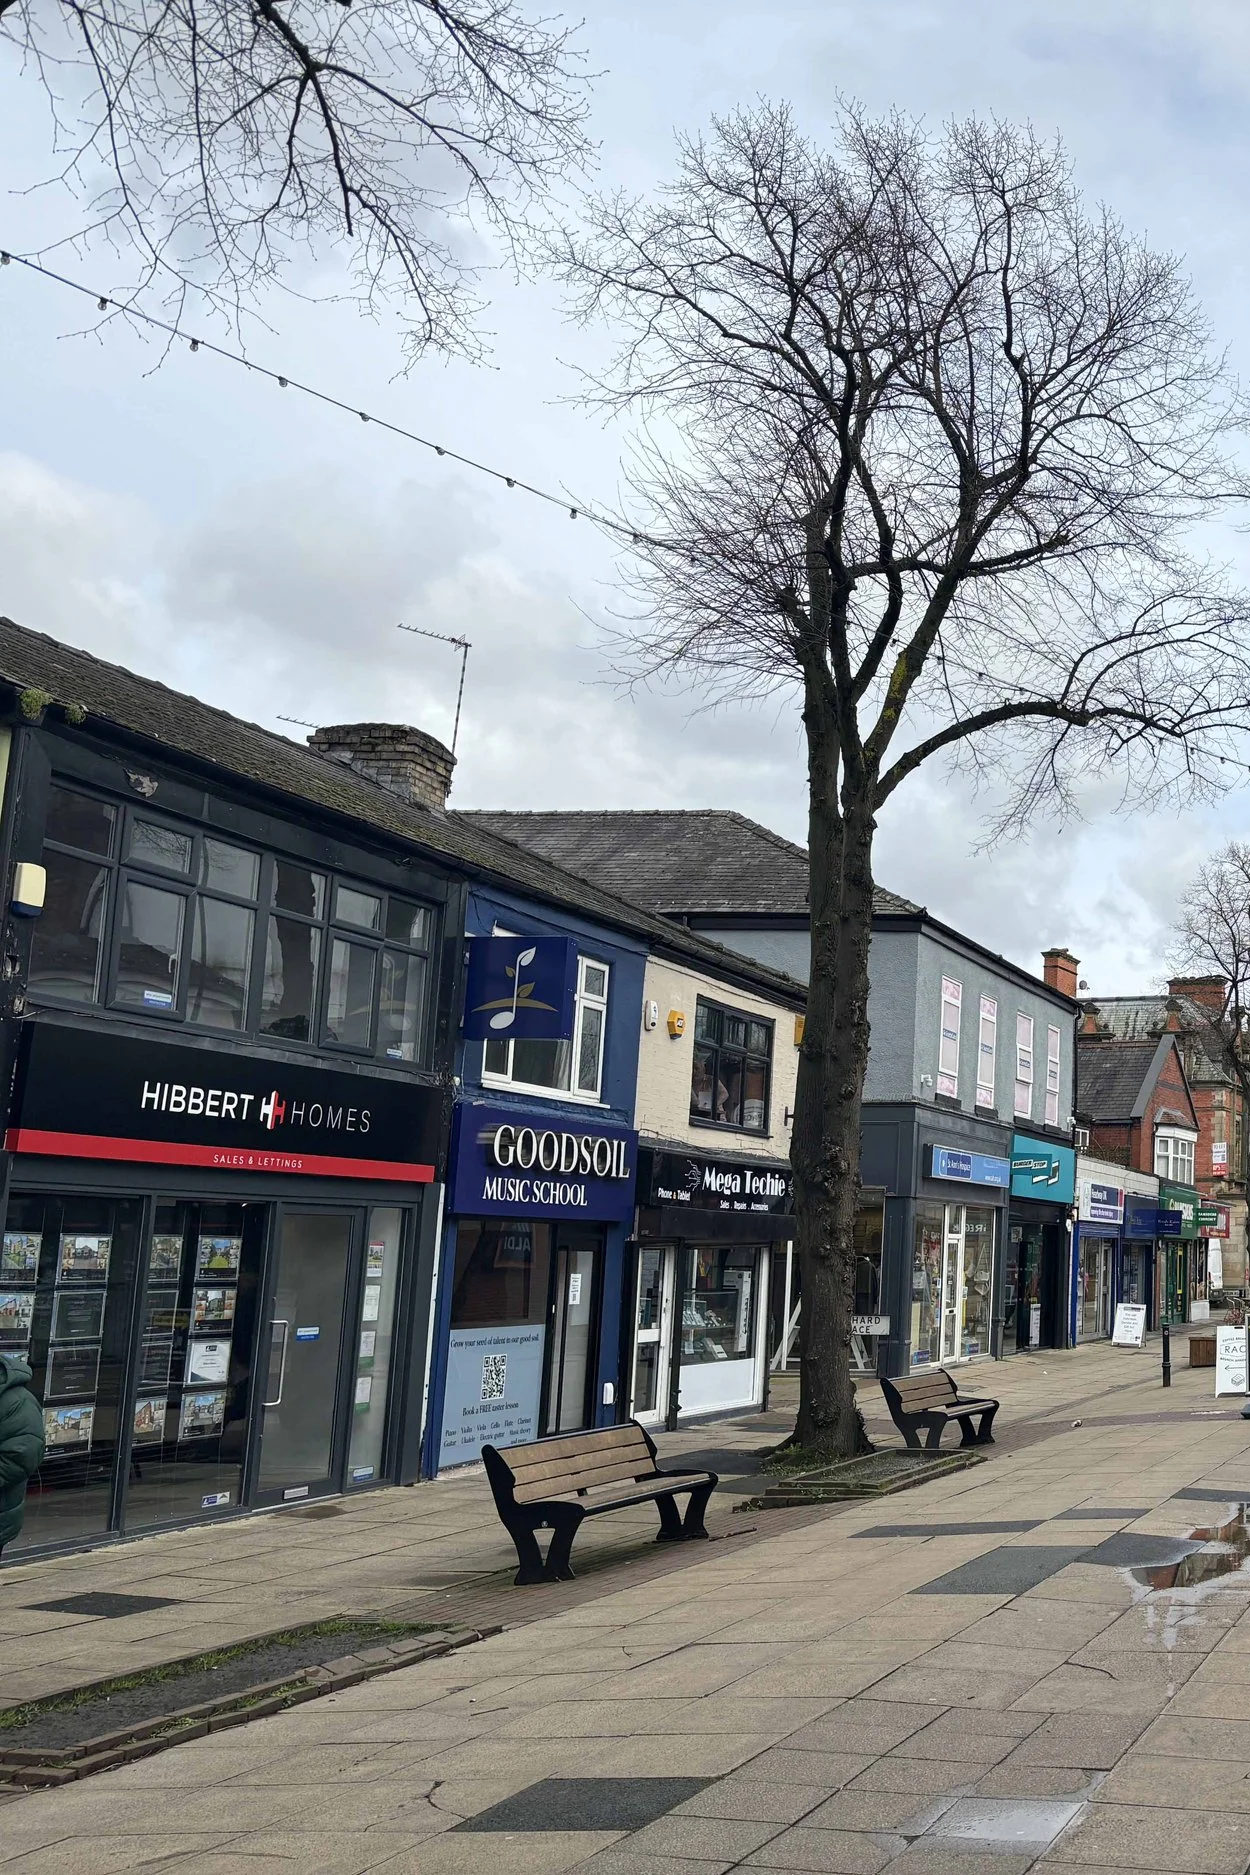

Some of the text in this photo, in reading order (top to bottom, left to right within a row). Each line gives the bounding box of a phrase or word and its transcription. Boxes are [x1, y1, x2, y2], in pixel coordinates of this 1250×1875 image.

[141, 1080, 254, 1121] HIBBERT
[290, 1101, 372, 1134] HOMES
[494, 1124, 630, 1178] GOODSOIL
[214, 1154, 302, 1169] SALES & LETTINGS
[702, 1166, 786, 1196] Mega Techie
[482, 1176, 587, 1206] MUSIC SCHOOL
[658, 1188, 672, 1199] Phone
[677, 1190, 690, 1201] Tablet
[720, 1200, 729, 1209] Sales
[734, 1201, 746, 1210] Repairs
[450, 1339, 463, 1348] Grow
[465, 1340, 476, 1349] your
[476, 1337, 487, 1346] seed
[487, 1336, 492, 1344] of
[520, 1334, 531, 1344] good
[462, 1406, 474, 1416] Book
[480, 1404, 492, 1413] FREE
